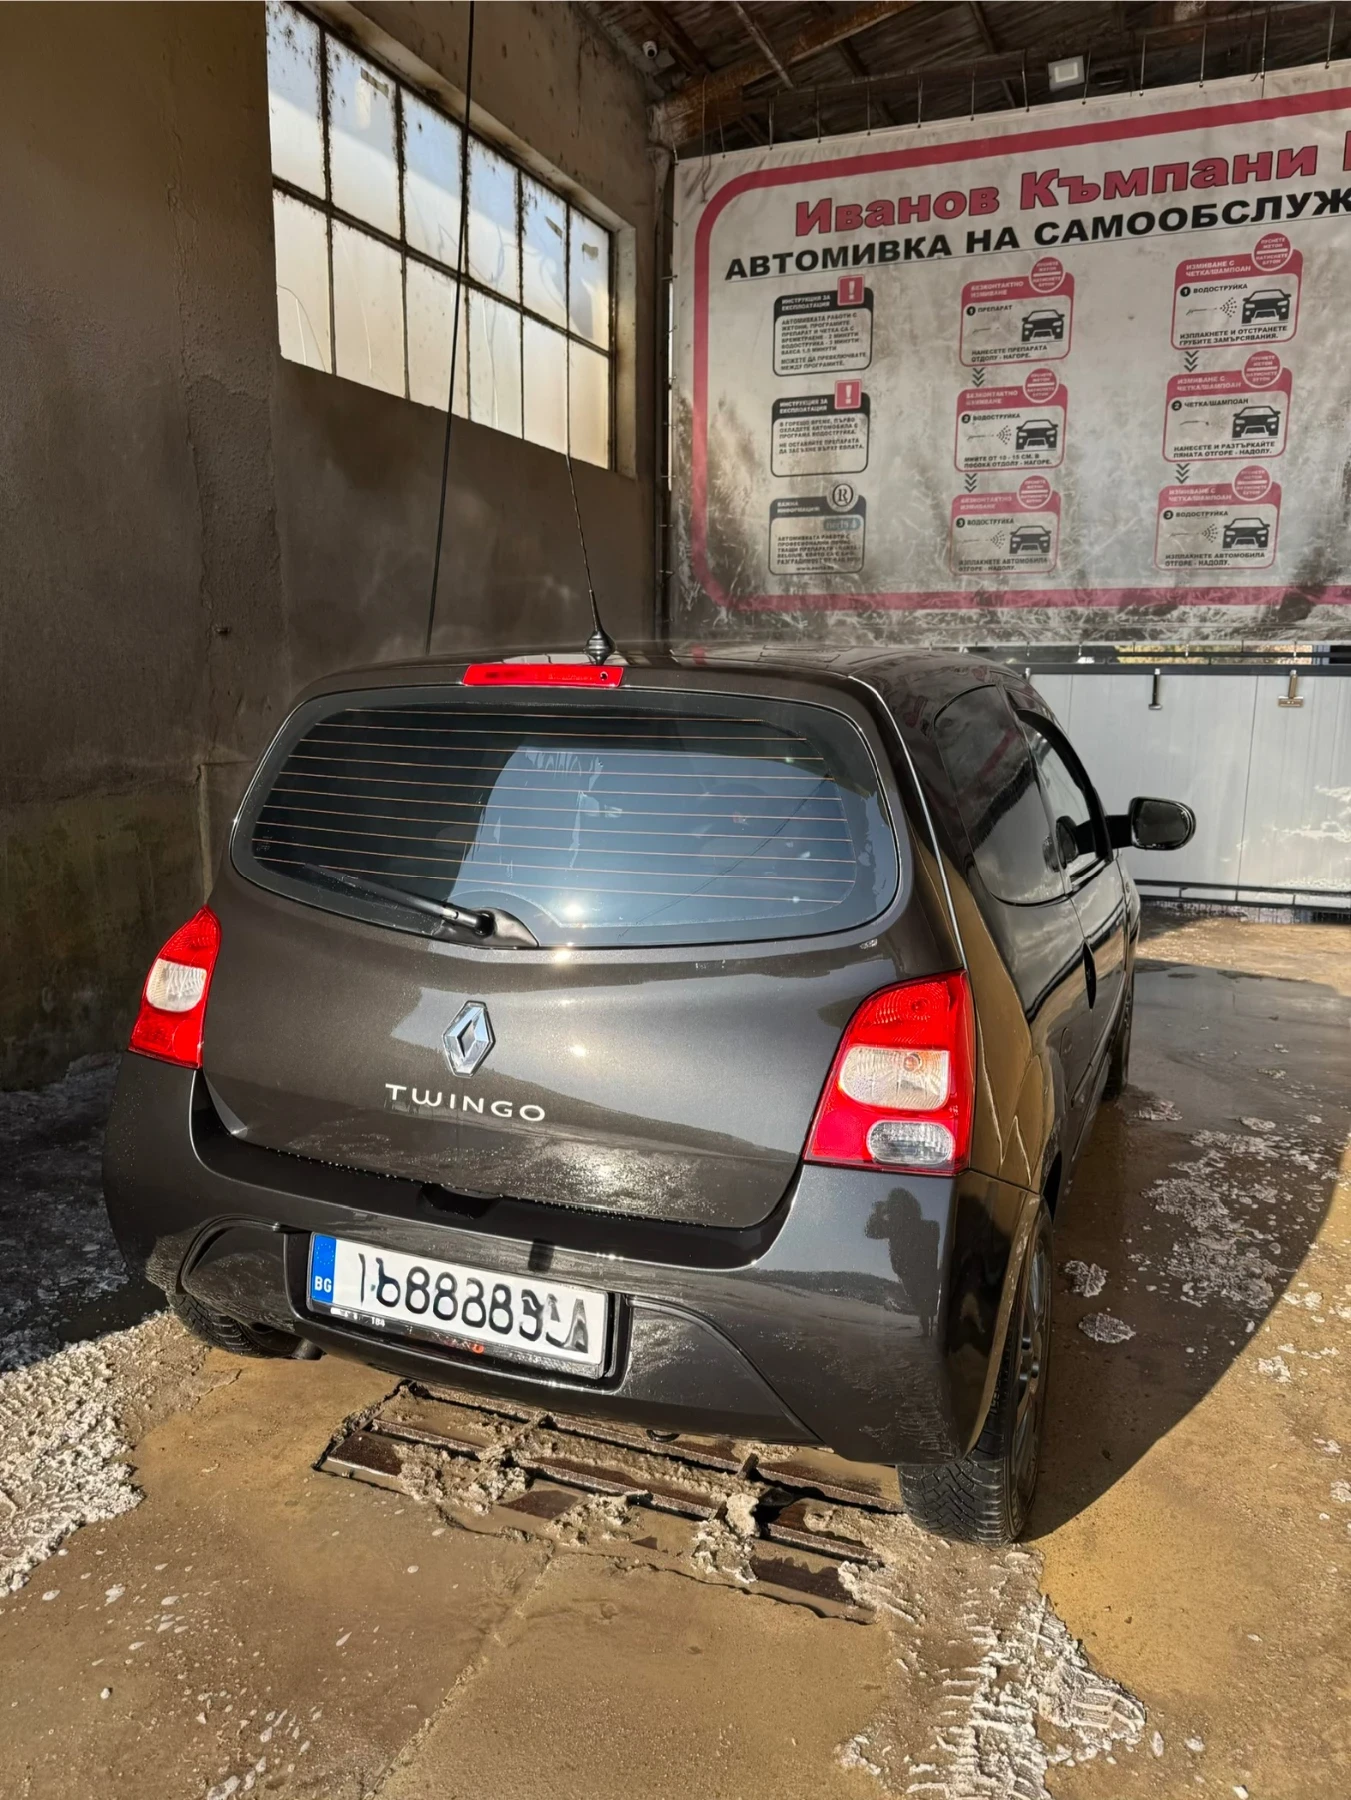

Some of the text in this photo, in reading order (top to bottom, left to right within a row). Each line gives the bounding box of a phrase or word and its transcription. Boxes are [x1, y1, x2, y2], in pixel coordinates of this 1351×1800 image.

[796, 186, 1000, 237] Иванов
[1020, 145, 1318, 210] Къмпани
[725, 188, 1351, 280] АВТОМИВКА НА САМООБСЛУЖ
[1186, 261, 1227, 270] ИЗМИВАНЕ
[1193, 284, 1248, 294] ВОДОСТРУЙКА
[827, 313, 850, 322] РАБОТИ
[1180, 330, 1228, 339] ИЗПЛАКНЕТЕ
[1238, 326, 1287, 335] ОТСТРАНЕТЕ
[1179, 337, 1212, 346] ГРУБИТЕ
[1008, 345, 1047, 353] ПРЕПАРАТА
[1174, 444, 1212, 452] НАНЕСЕТЕ
[967, 518, 1014, 526] ВОДОСТРУЙКА
[385, 1083, 545, 1122] TWINGO
[315, 1276, 332, 1293] BG
